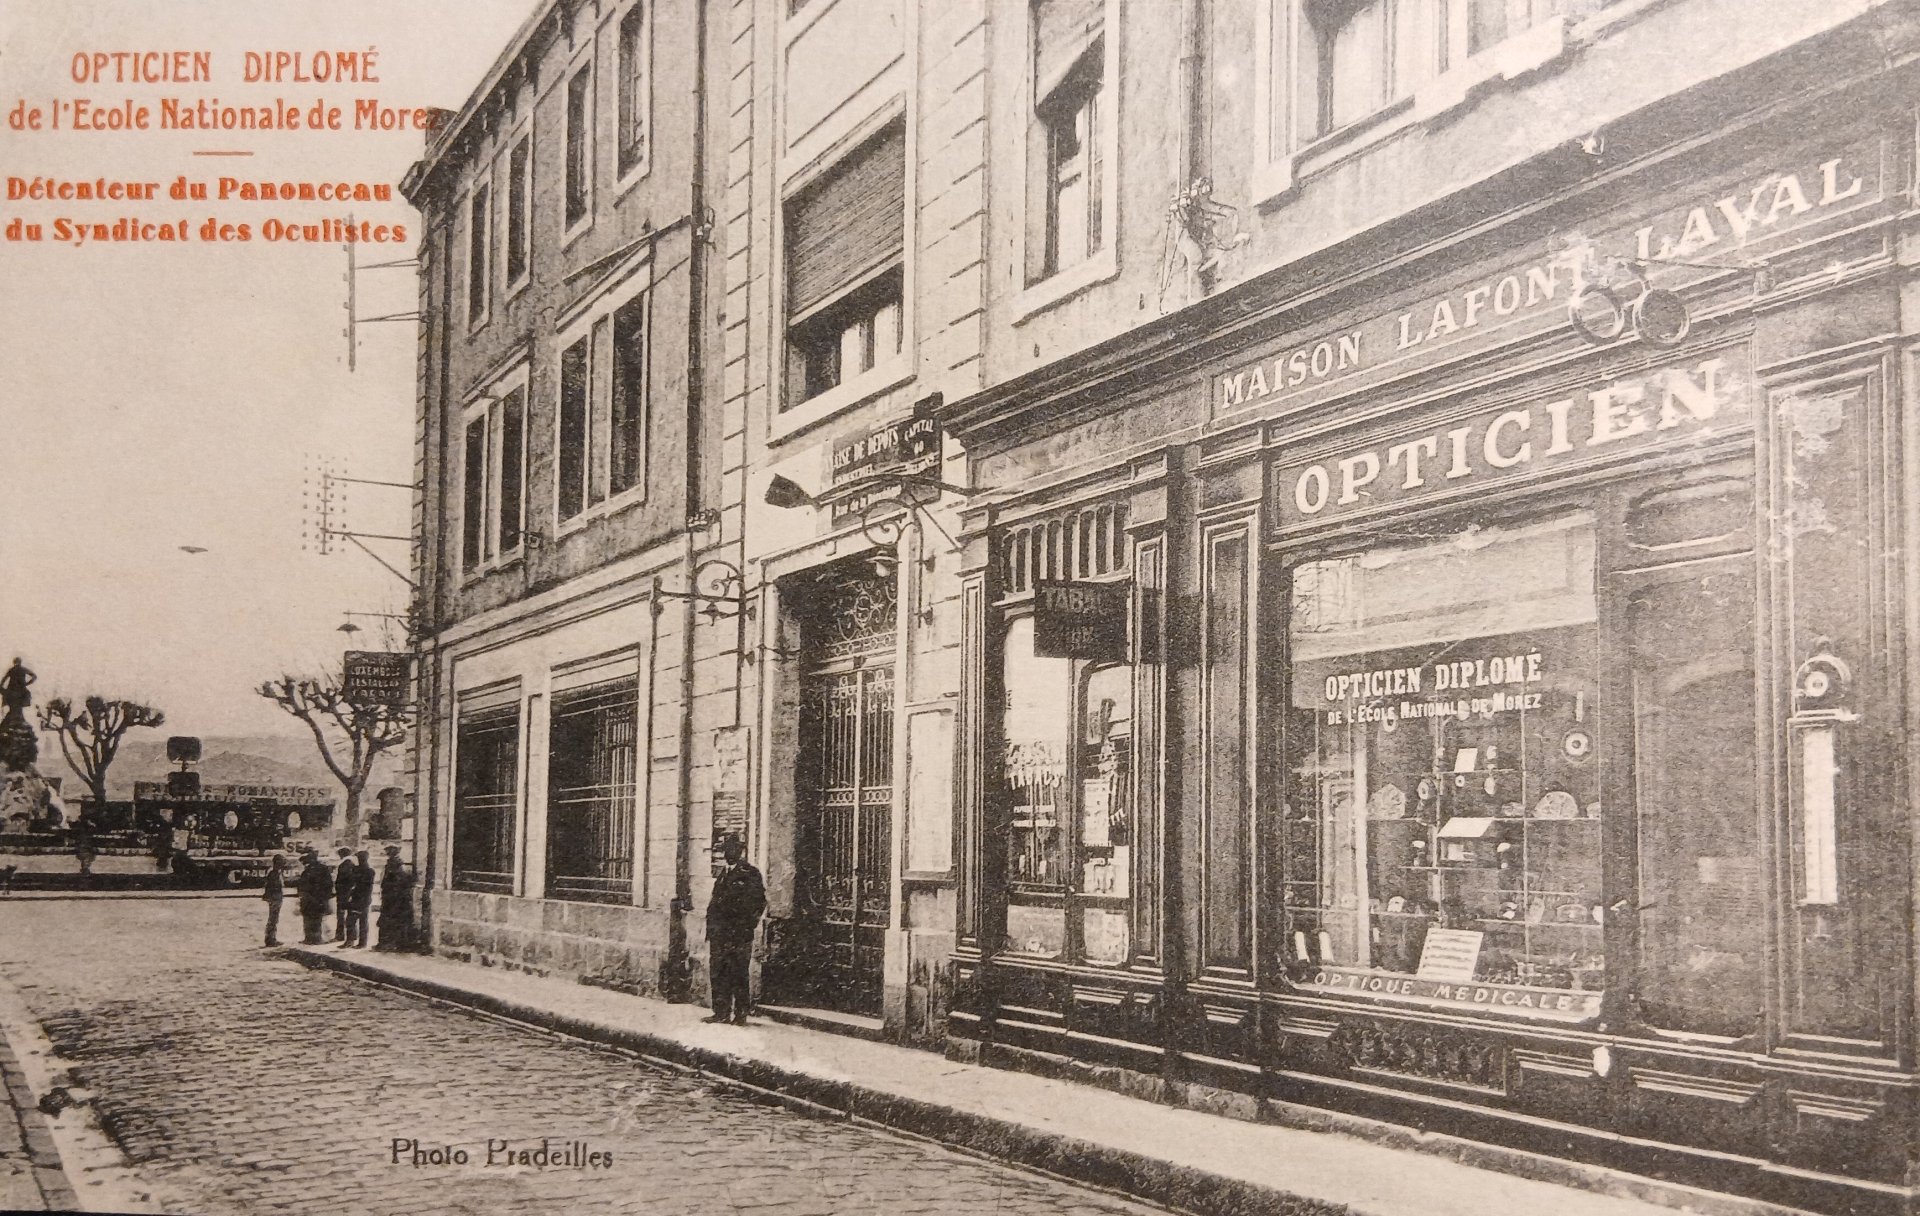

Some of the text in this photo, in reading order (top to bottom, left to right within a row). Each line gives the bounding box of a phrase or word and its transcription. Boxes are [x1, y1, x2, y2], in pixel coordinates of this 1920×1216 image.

[1221, 330, 1363, 409] MAISON
[1634, 157, 1864, 267] LAVAL
[1294, 358, 1725, 515] OPTICIEN
[1325, 647, 1542, 701] OPTICIEN DIPLOMÉ
[1328, 710, 1343, 726] DE
[1493, 691, 1542, 711] MOREZ
[1313, 972, 1574, 1010] OPTIQUE MEDICALE
